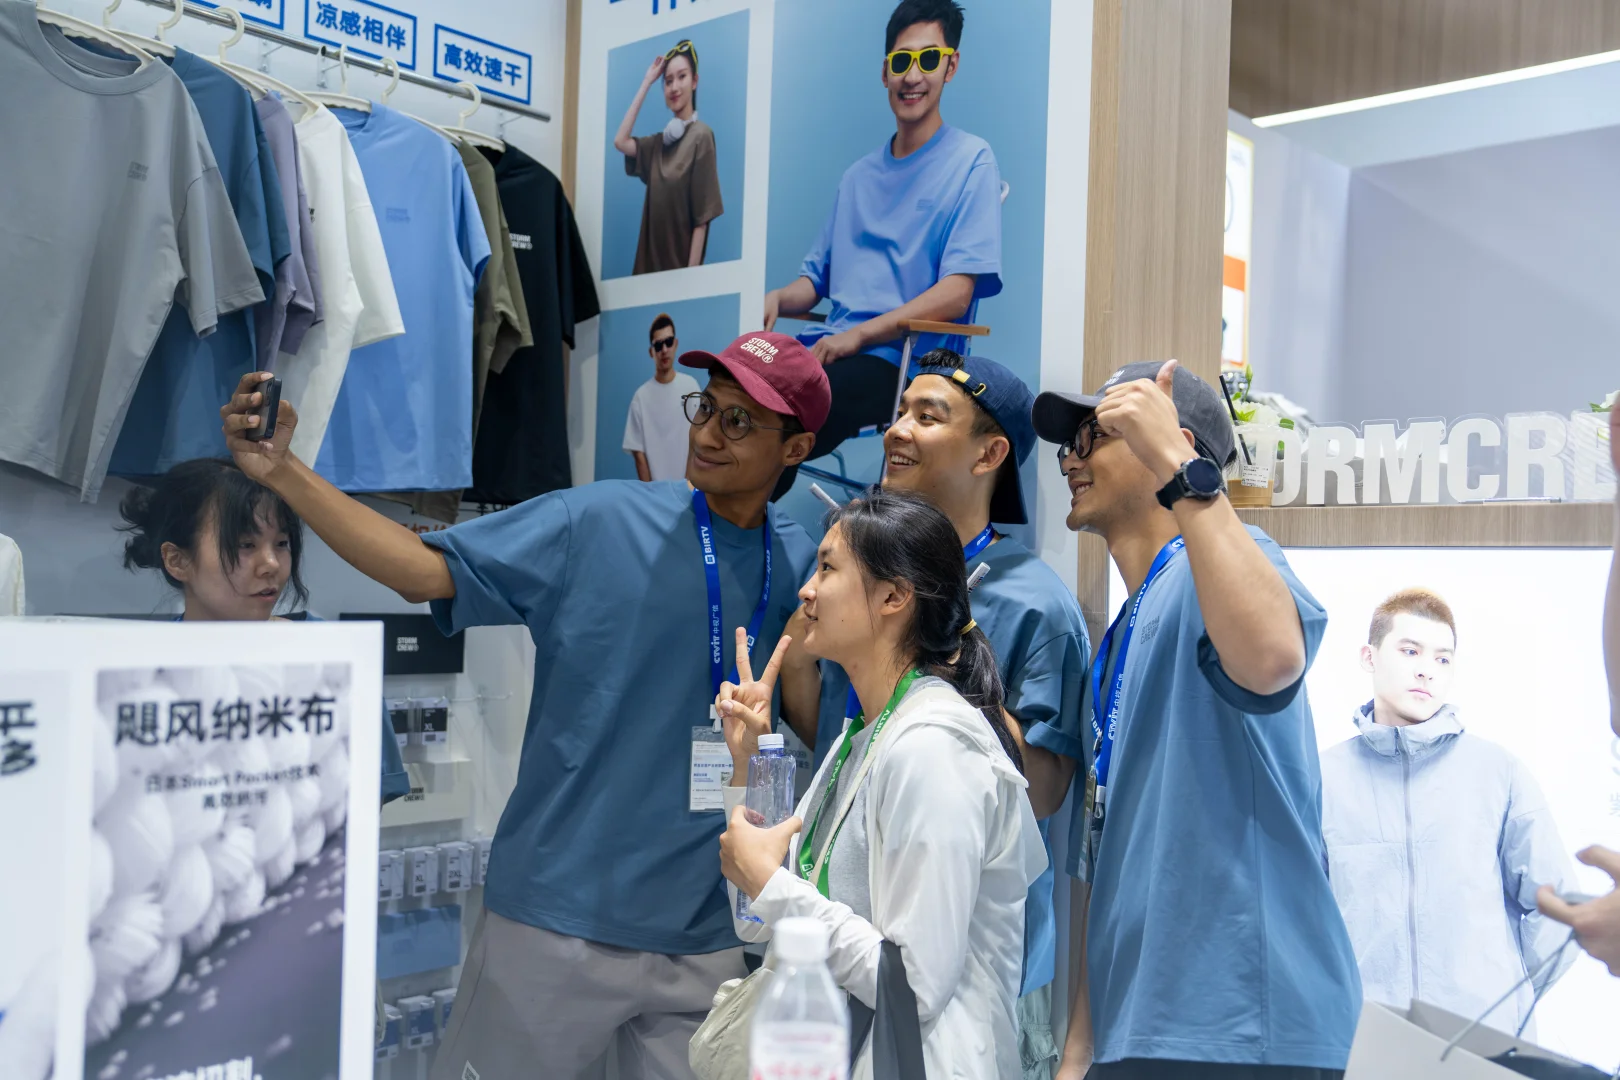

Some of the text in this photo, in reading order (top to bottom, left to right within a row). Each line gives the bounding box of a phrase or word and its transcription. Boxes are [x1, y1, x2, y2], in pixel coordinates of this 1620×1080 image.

[315, 1, 406, 51] 凉感相伴
[443, 43, 522, 86] 高效速干
[748, 338, 779, 356] STORM
[701, 526, 711, 554] BIRTV
[115, 692, 336, 747] 飓风纳米布
